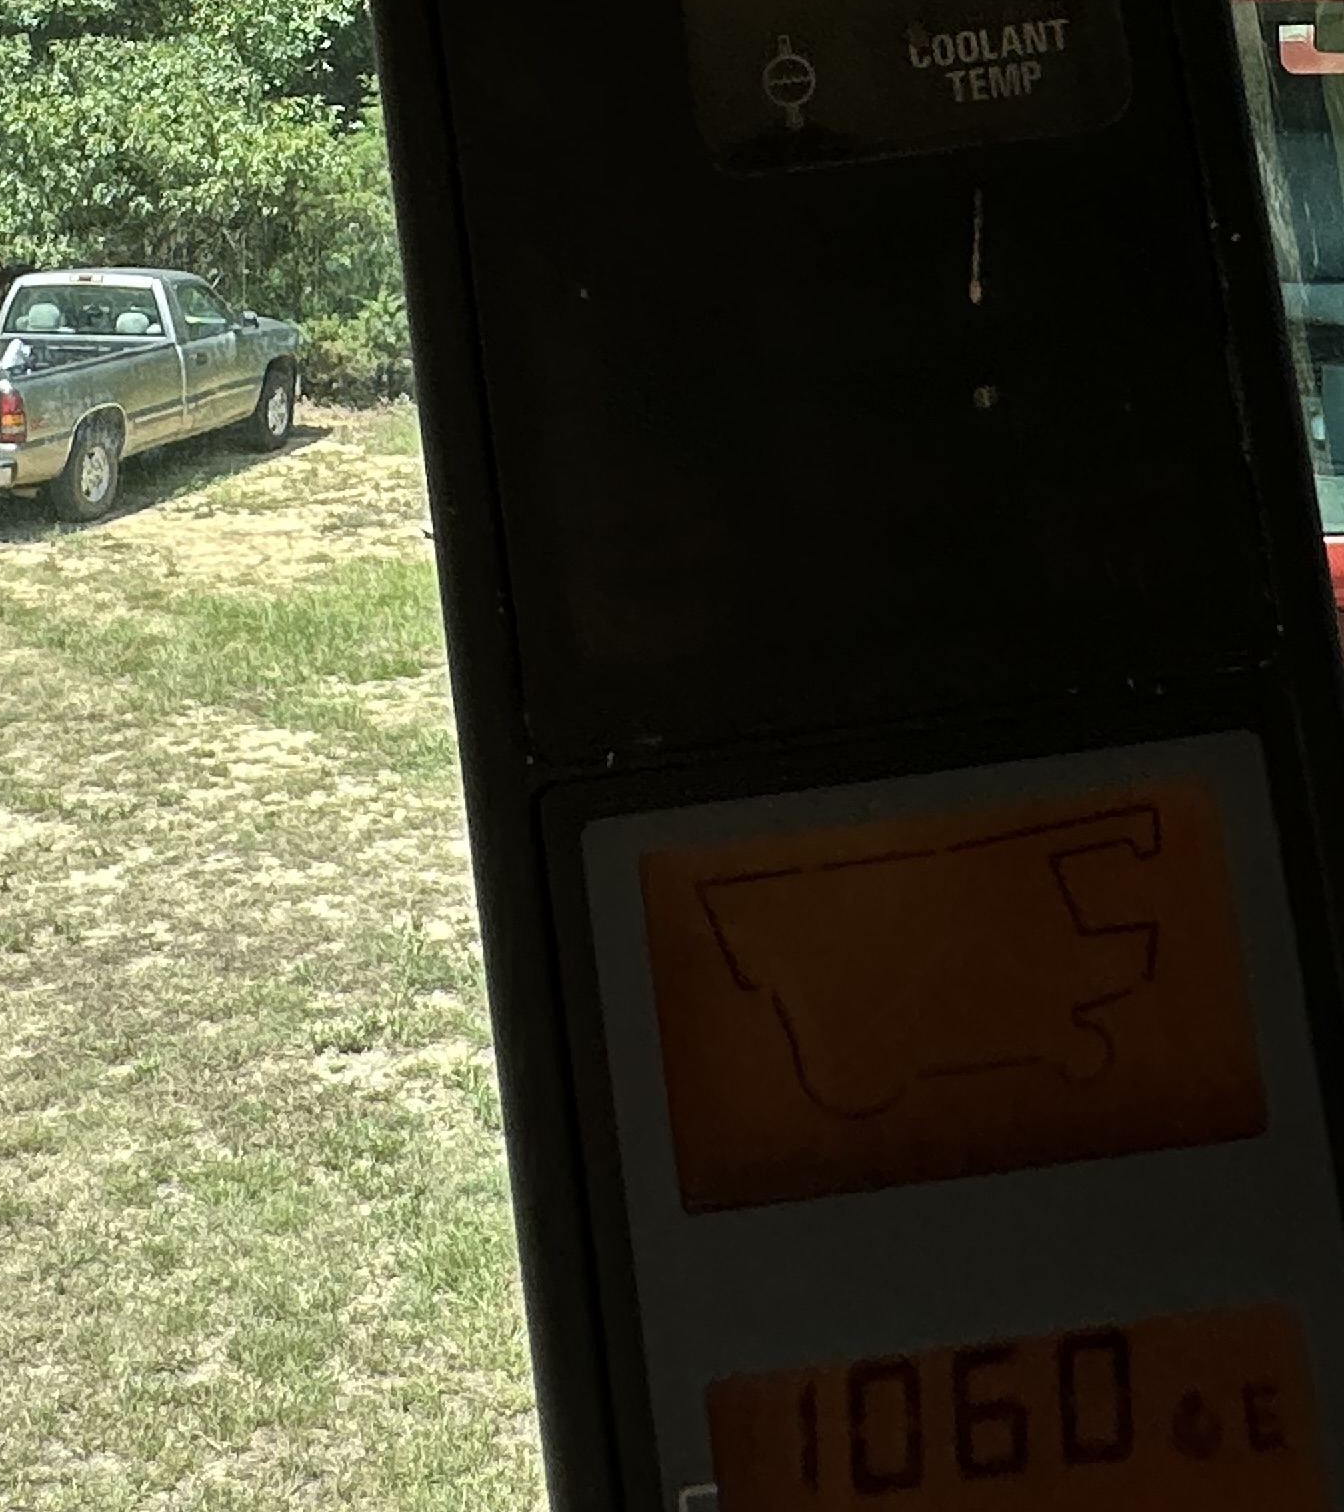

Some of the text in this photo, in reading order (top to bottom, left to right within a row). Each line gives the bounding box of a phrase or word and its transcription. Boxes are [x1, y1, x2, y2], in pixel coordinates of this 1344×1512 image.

[908, 18, 1071, 69] COOLANT
[944, 61, 1042, 103] TEMP
[798, 1326, 1134, 1494] 1060
